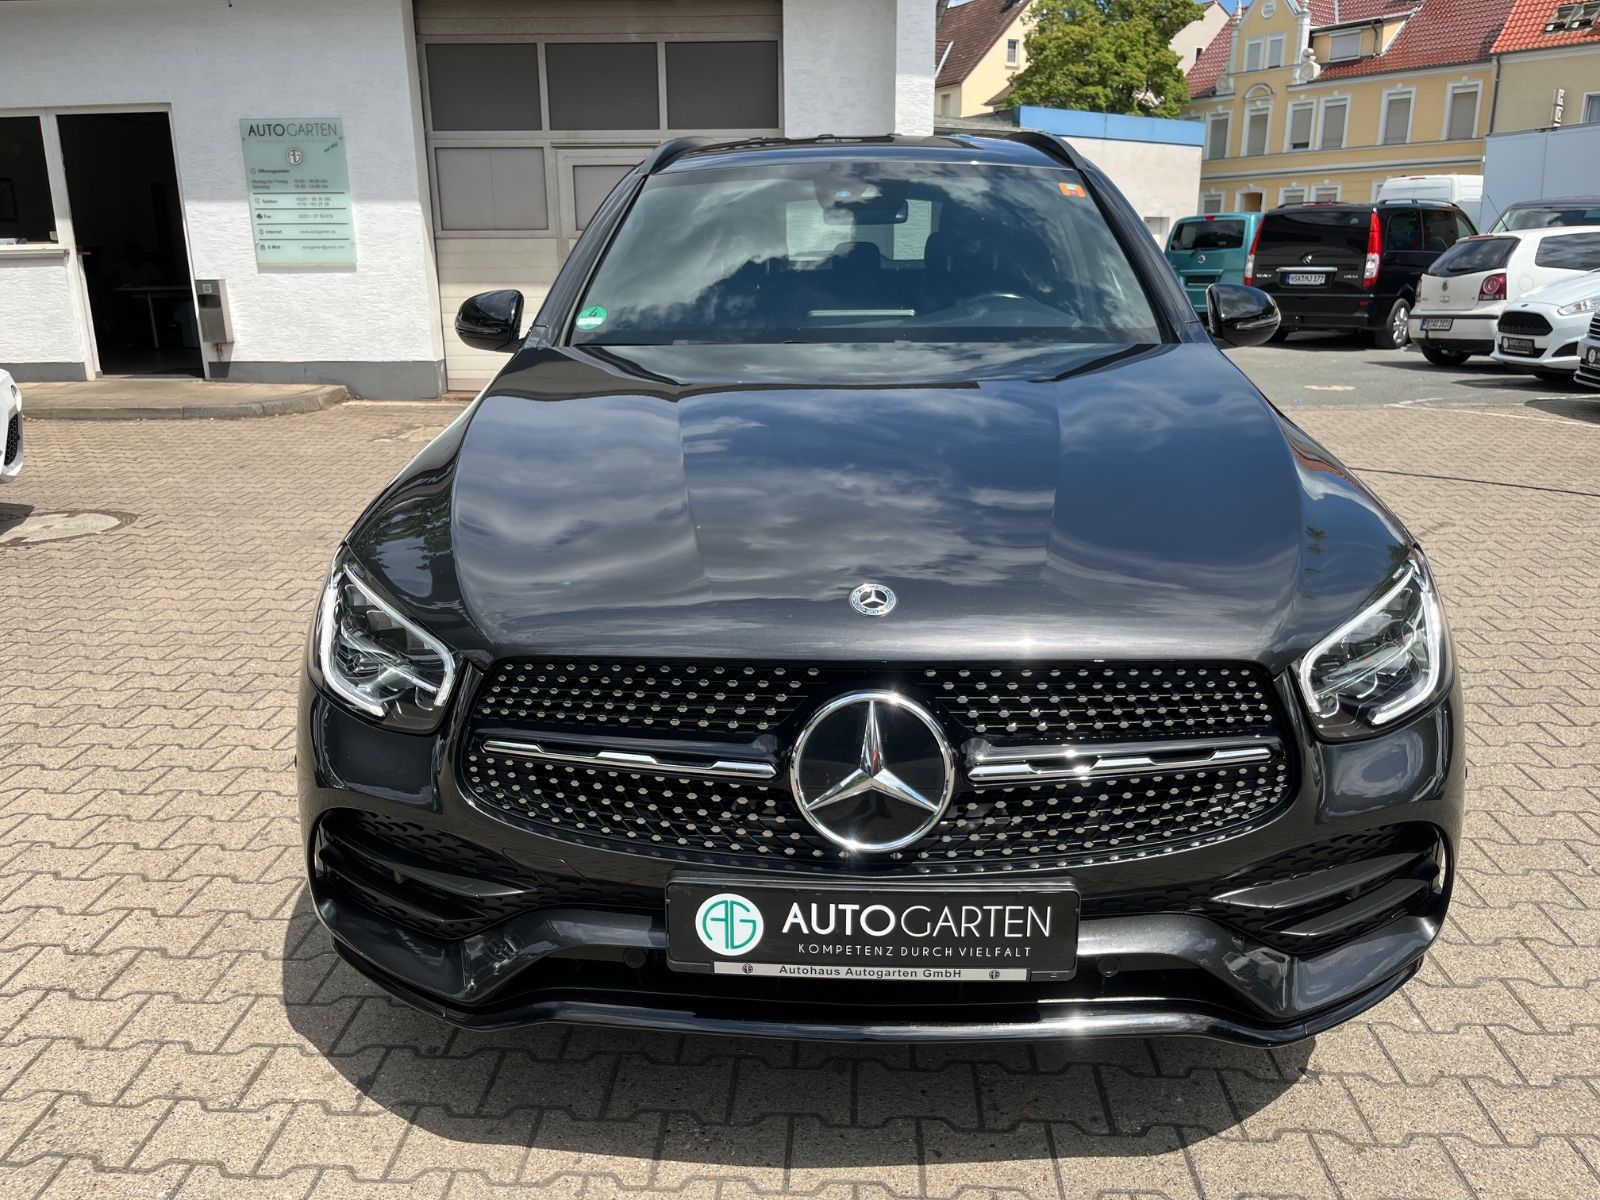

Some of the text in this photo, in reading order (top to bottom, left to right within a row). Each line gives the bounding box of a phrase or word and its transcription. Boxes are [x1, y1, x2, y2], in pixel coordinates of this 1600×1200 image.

[248, 123, 337, 137] AUTOGARTEN
[589, 307, 597, 317] 4
[781, 902, 1051, 938] AUTOGARTEN
[798, 943, 1031, 957] KOMPETENZ DURCH VIELFALT
[779, 965, 962, 980] Autohaus Autogarten GmbH
